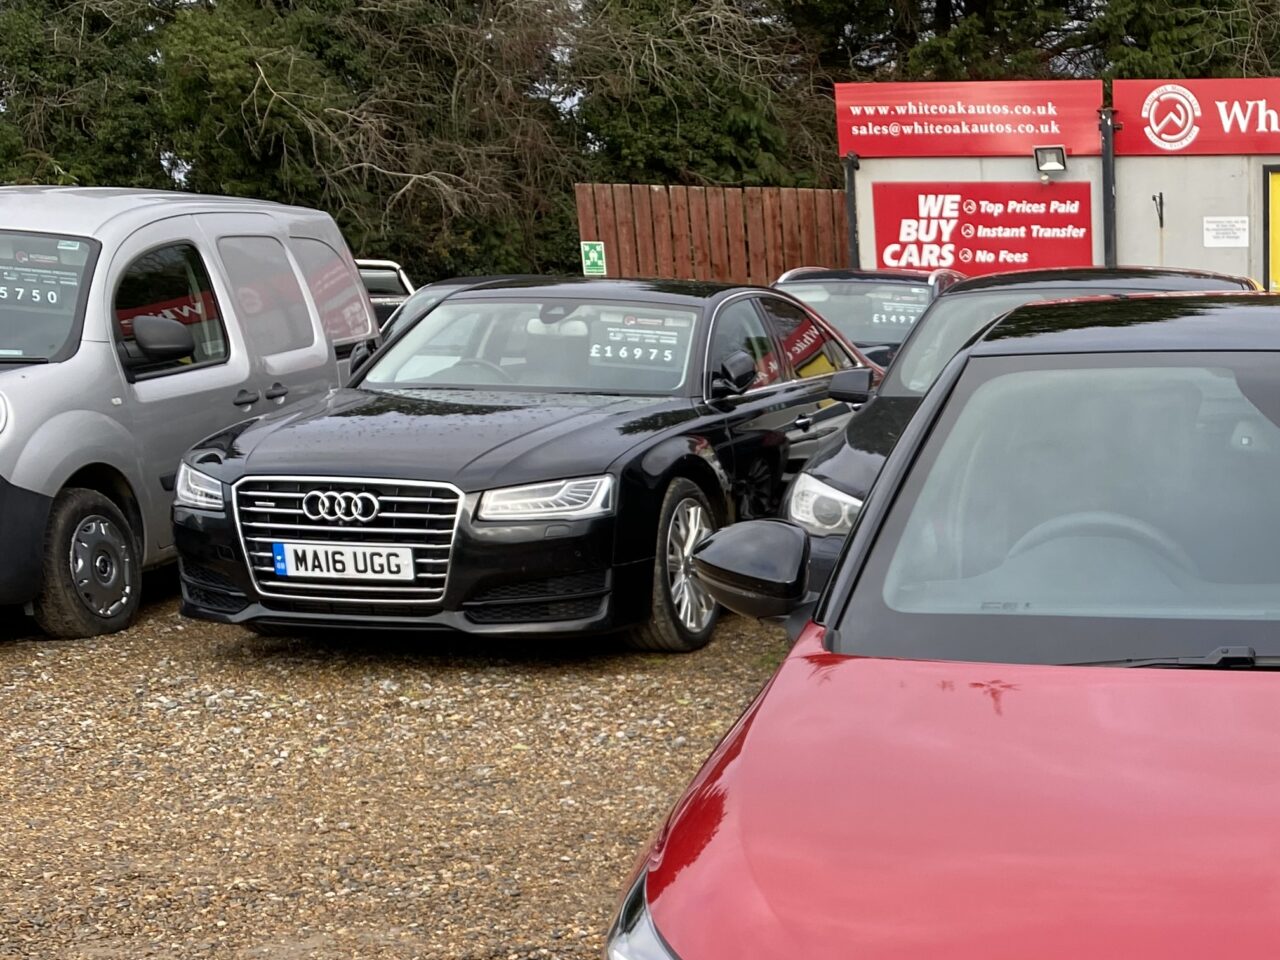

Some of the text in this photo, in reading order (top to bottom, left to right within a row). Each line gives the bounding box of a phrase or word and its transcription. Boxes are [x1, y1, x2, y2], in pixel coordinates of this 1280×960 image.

[850, 101, 1058, 117] www.whiteoakautos.co.uk
[851, 120, 1061, 136] sales@whiteoakautos.co.uk
[918, 194, 961, 218] WE
[979, 200, 1080, 216] Top Prices Paid
[899, 219, 957, 243] BUY
[976, 224, 1086, 239] Instant Transfer
[883, 243, 955, 268] CARS
[975, 249, 1029, 263] No Fees
[590, 344, 673, 361] £16975
[293, 549, 402, 575] MA16 UGG
